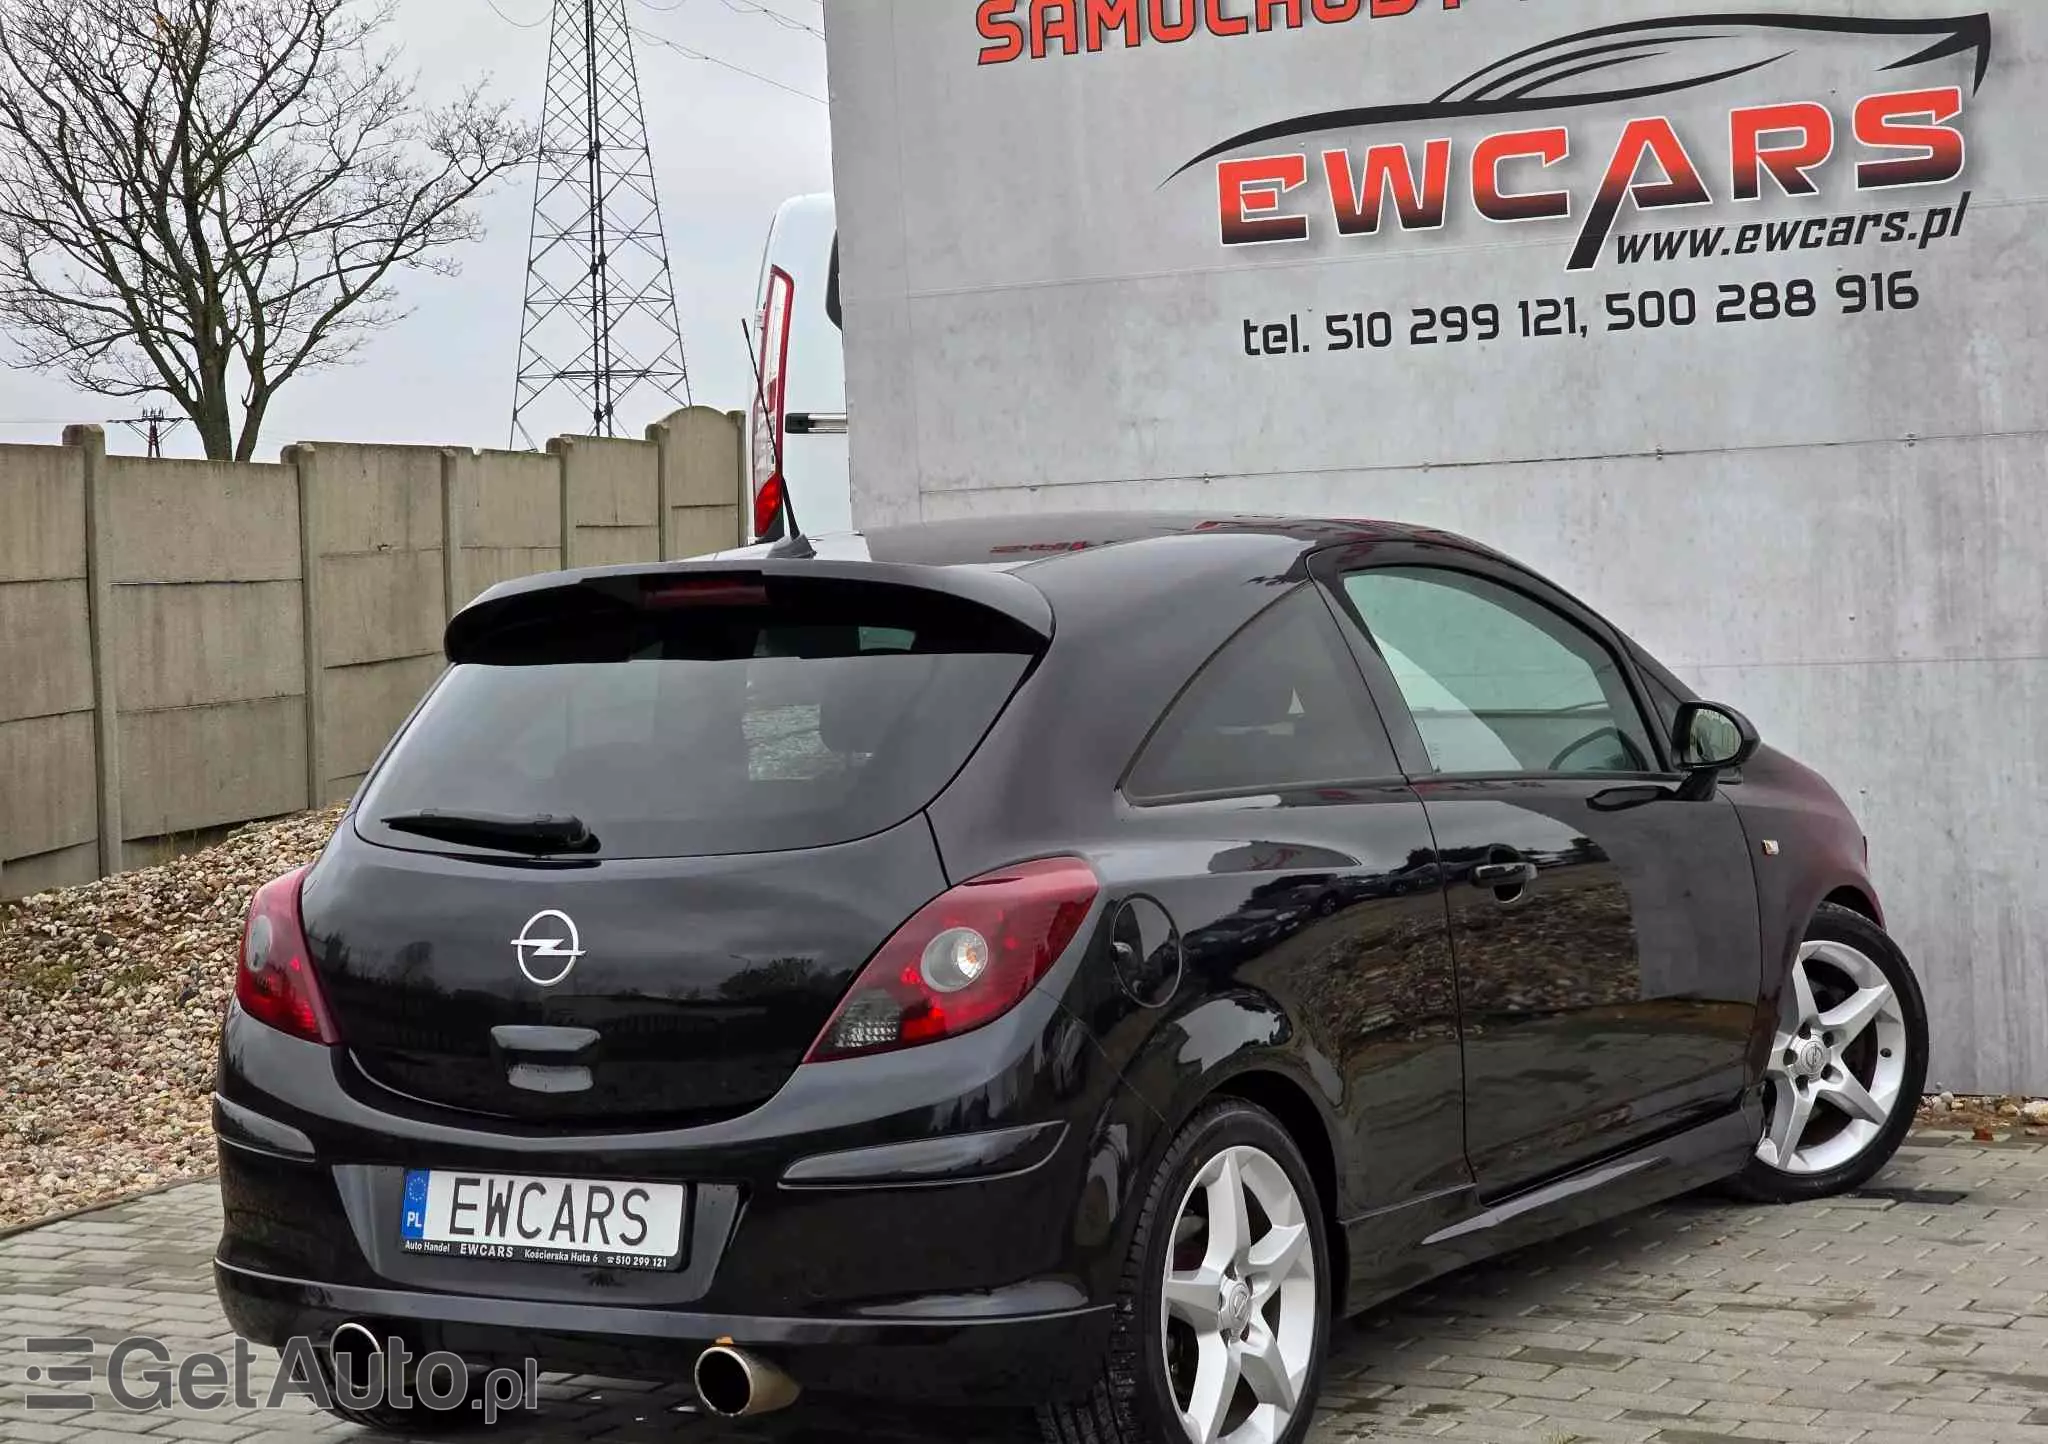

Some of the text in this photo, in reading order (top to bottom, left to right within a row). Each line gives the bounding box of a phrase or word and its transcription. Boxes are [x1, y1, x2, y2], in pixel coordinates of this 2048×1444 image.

[976, 0, 1461, 65] SAMOC
[1217, 85, 1966, 272] EWCARS
[1616, 190, 1972, 265] www.ewcars.pl
[1243, 269, 1919, 356] tel. 510 299 121, 500 288 916
[407, 1211, 422, 1227] PL
[449, 1177, 650, 1246] EWCARS
[405, 1240, 423, 1251] Auto
[424, 1241, 450, 1253] Handel
[460, 1243, 514, 1258] EWCARS
[570, 1253, 591, 1263] Huta
[592, 1255, 599, 1263] 6
[615, 1256, 631, 1266] 510
[633, 1257, 650, 1267] 299
[652, 1258, 668, 1268] 121
